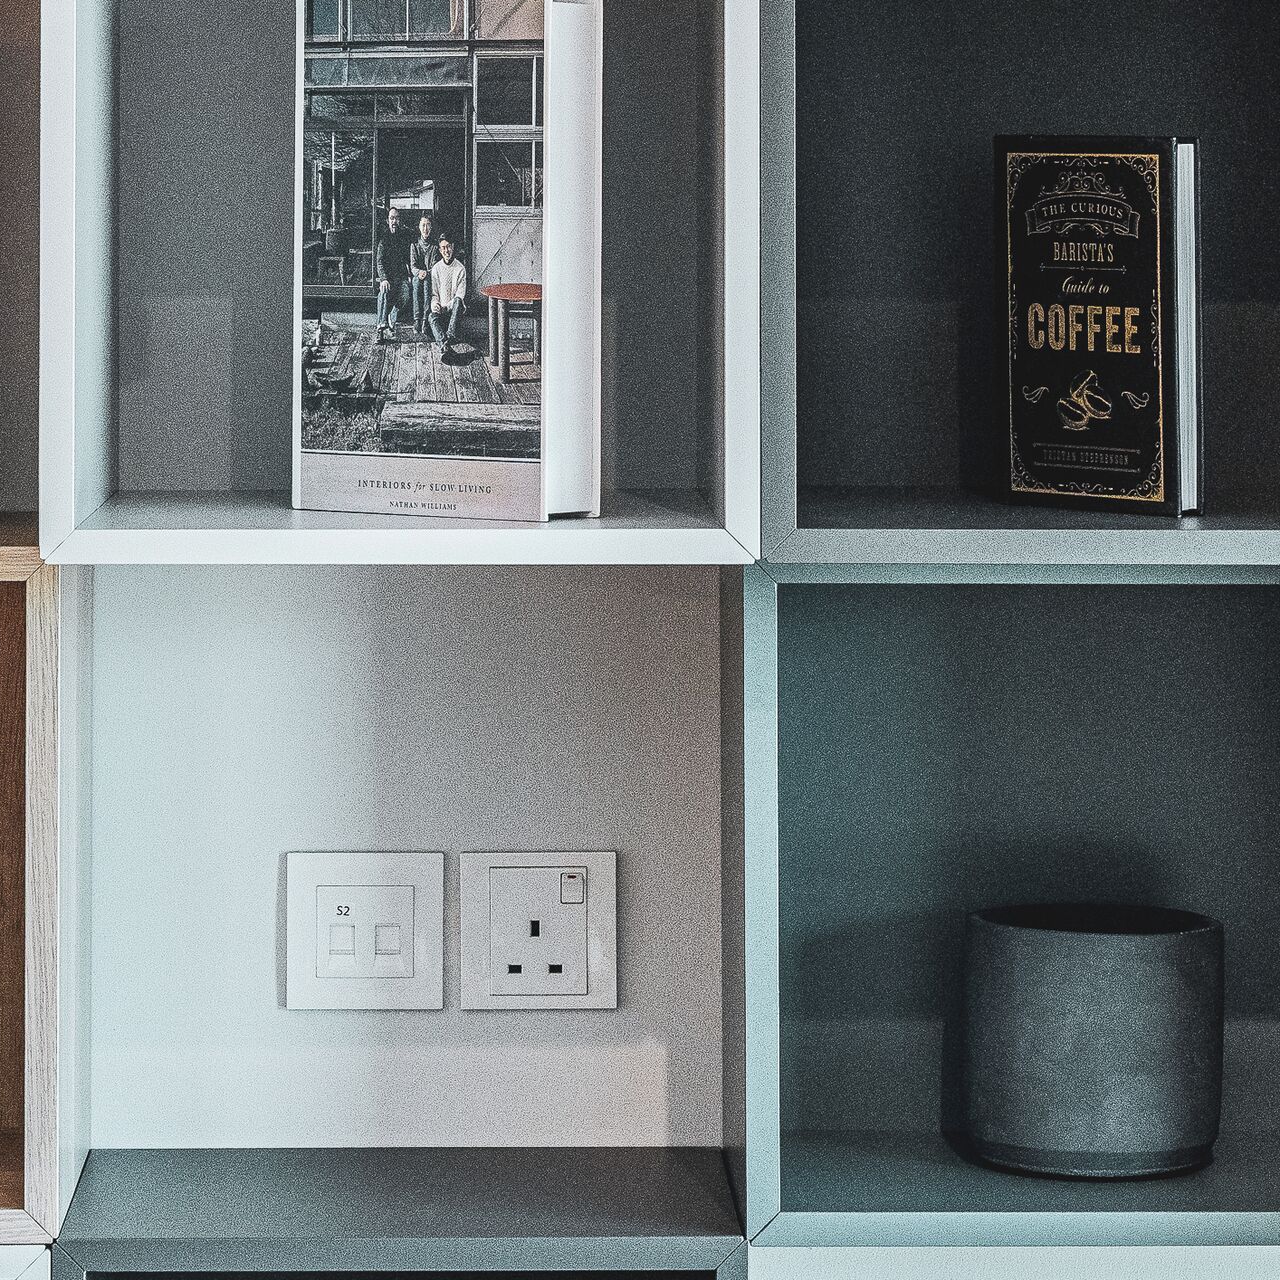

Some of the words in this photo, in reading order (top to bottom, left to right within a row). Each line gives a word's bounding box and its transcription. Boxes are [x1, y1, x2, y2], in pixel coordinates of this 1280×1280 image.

[1042, 204, 1066, 217] THE
[1071, 203, 1123, 219] CURIOUS
[1053, 242, 1114, 262] BARISTA'S
[1062, 276, 1095, 296] Guide
[1099, 283, 1110, 294] to
[1027, 303, 1141, 354] COFFEE
[358, 480, 411, 490] INTERIORS
[413, 481, 425, 493] for
[429, 483, 454, 492] SLOW
[458, 484, 492, 494] LIVING
[389, 501, 418, 509] NATHAN
[421, 502, 457, 510] WILLIAMS
[336, 905, 350, 917] S2
